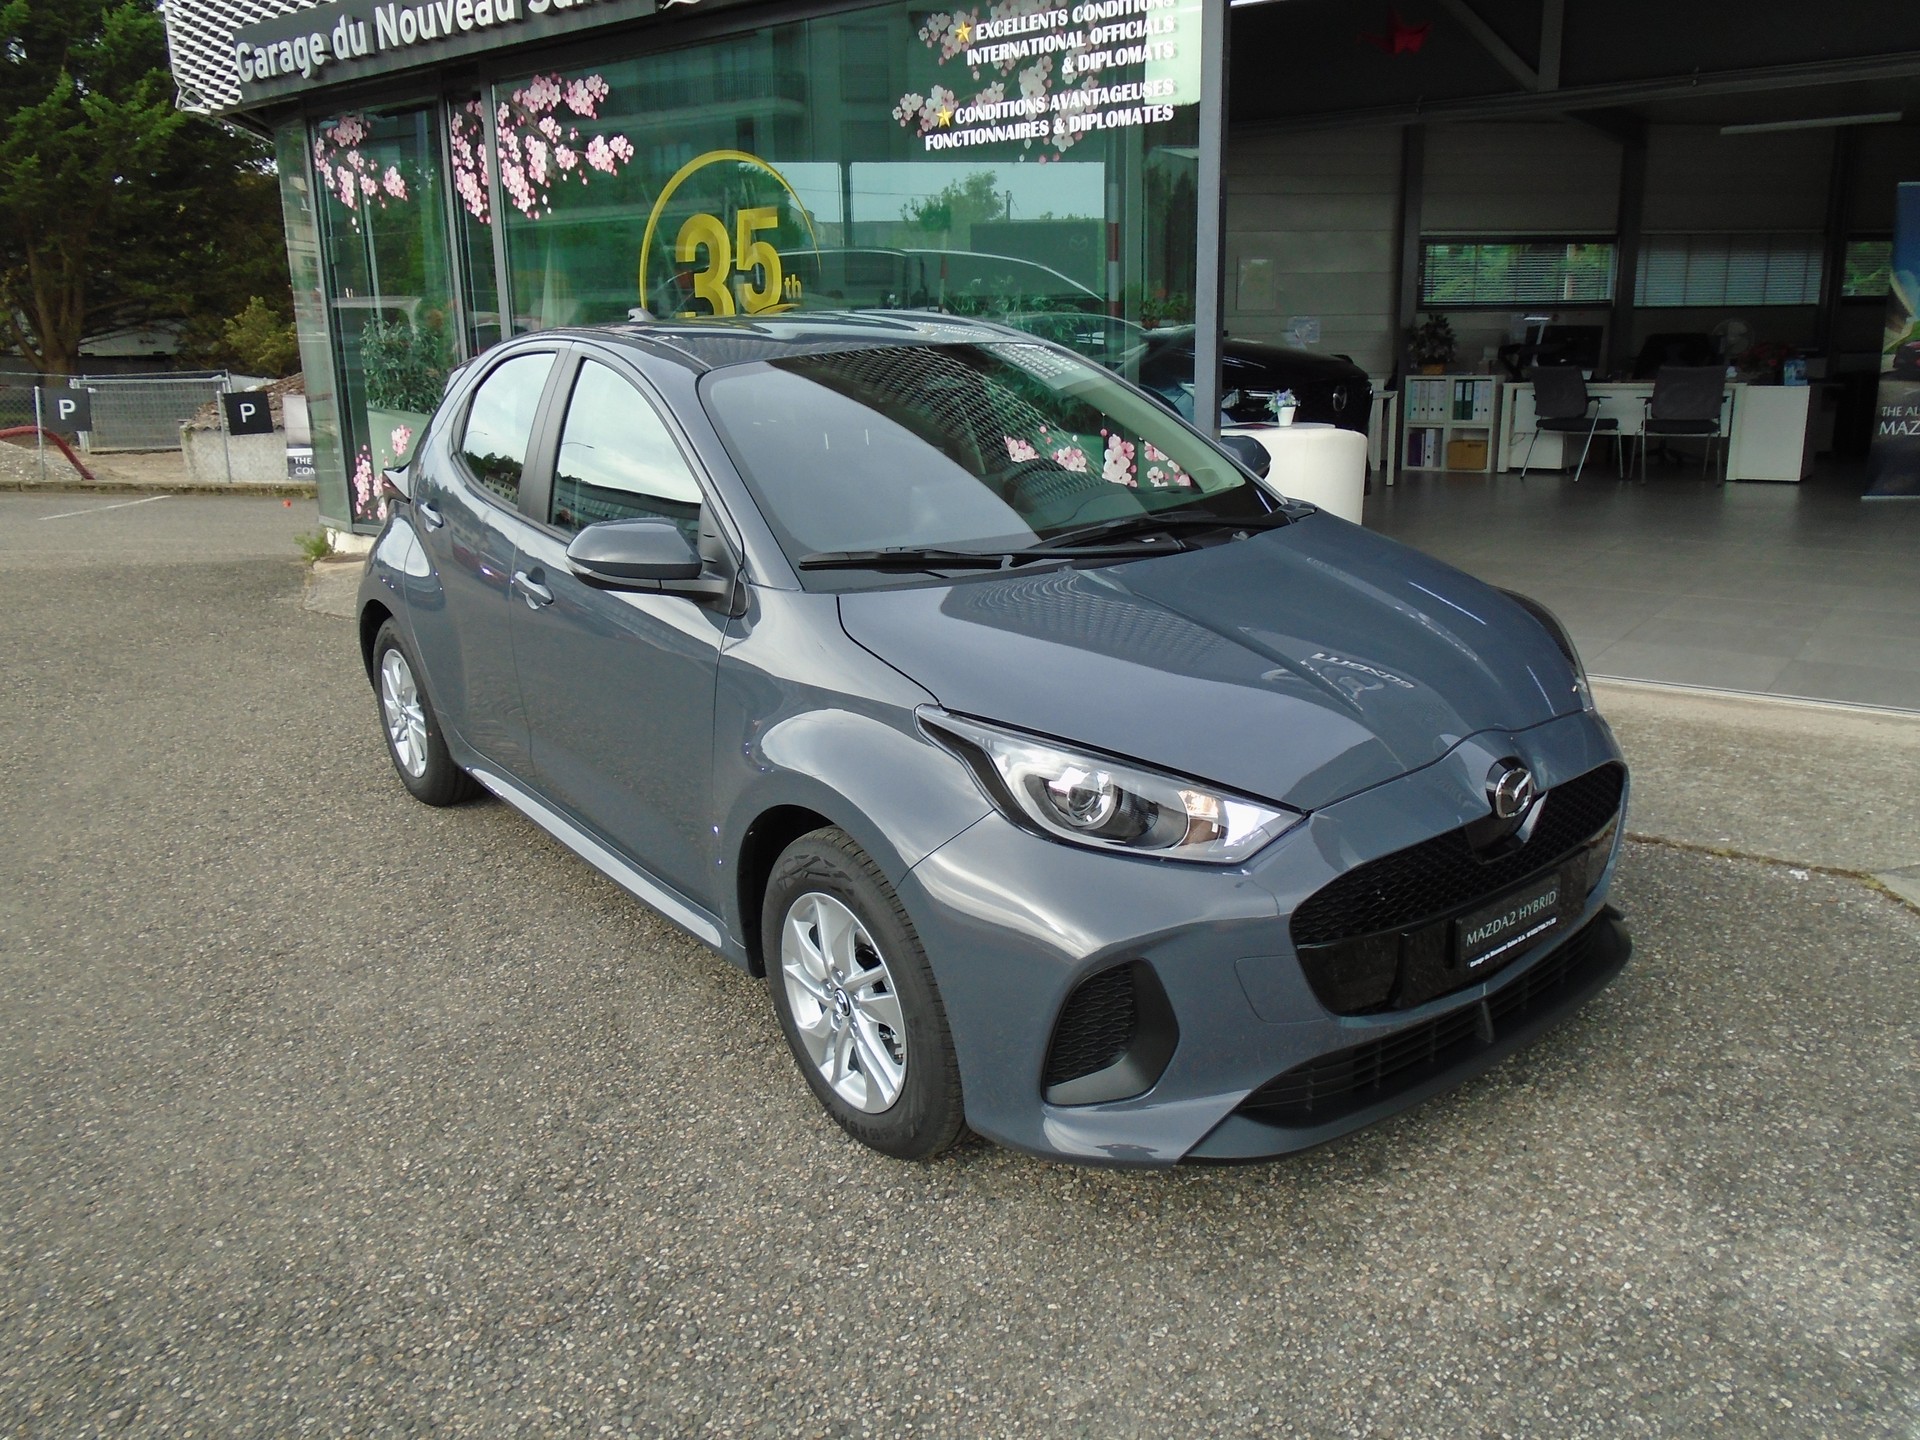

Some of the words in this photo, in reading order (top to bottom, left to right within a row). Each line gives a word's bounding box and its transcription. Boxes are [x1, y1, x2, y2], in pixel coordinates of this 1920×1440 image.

[235, 33, 325, 83] Garage
[333, 15, 367, 60] du
[375, 0, 514, 50] Nouveau
[967, 35, 1087, 66] INTERNATIONAL
[1090, 15, 1176, 45] OFFICIALS
[975, 9, 1068, 41] EXCELLENTS
[1062, 56, 1075, 75] &
[1078, 41, 1176, 71] DIPLOMATS
[955, 97, 1046, 124] CONDITIONS
[1049, 79, 1175, 112] AVANTAGEUSES
[925, 120, 1050, 151] FONCTIONNAIRES
[1053, 118, 1066, 136] &
[1068, 105, 1175, 134] DIPLOMATES
[58, 399, 76, 421] P
[239, 403, 256, 423] P
[1881, 406, 1903, 417] THE
[293, 456, 313, 465] THE
[1466, 911, 1516, 947] MAZDA2
[1519, 891, 1557, 921] HYBRID
